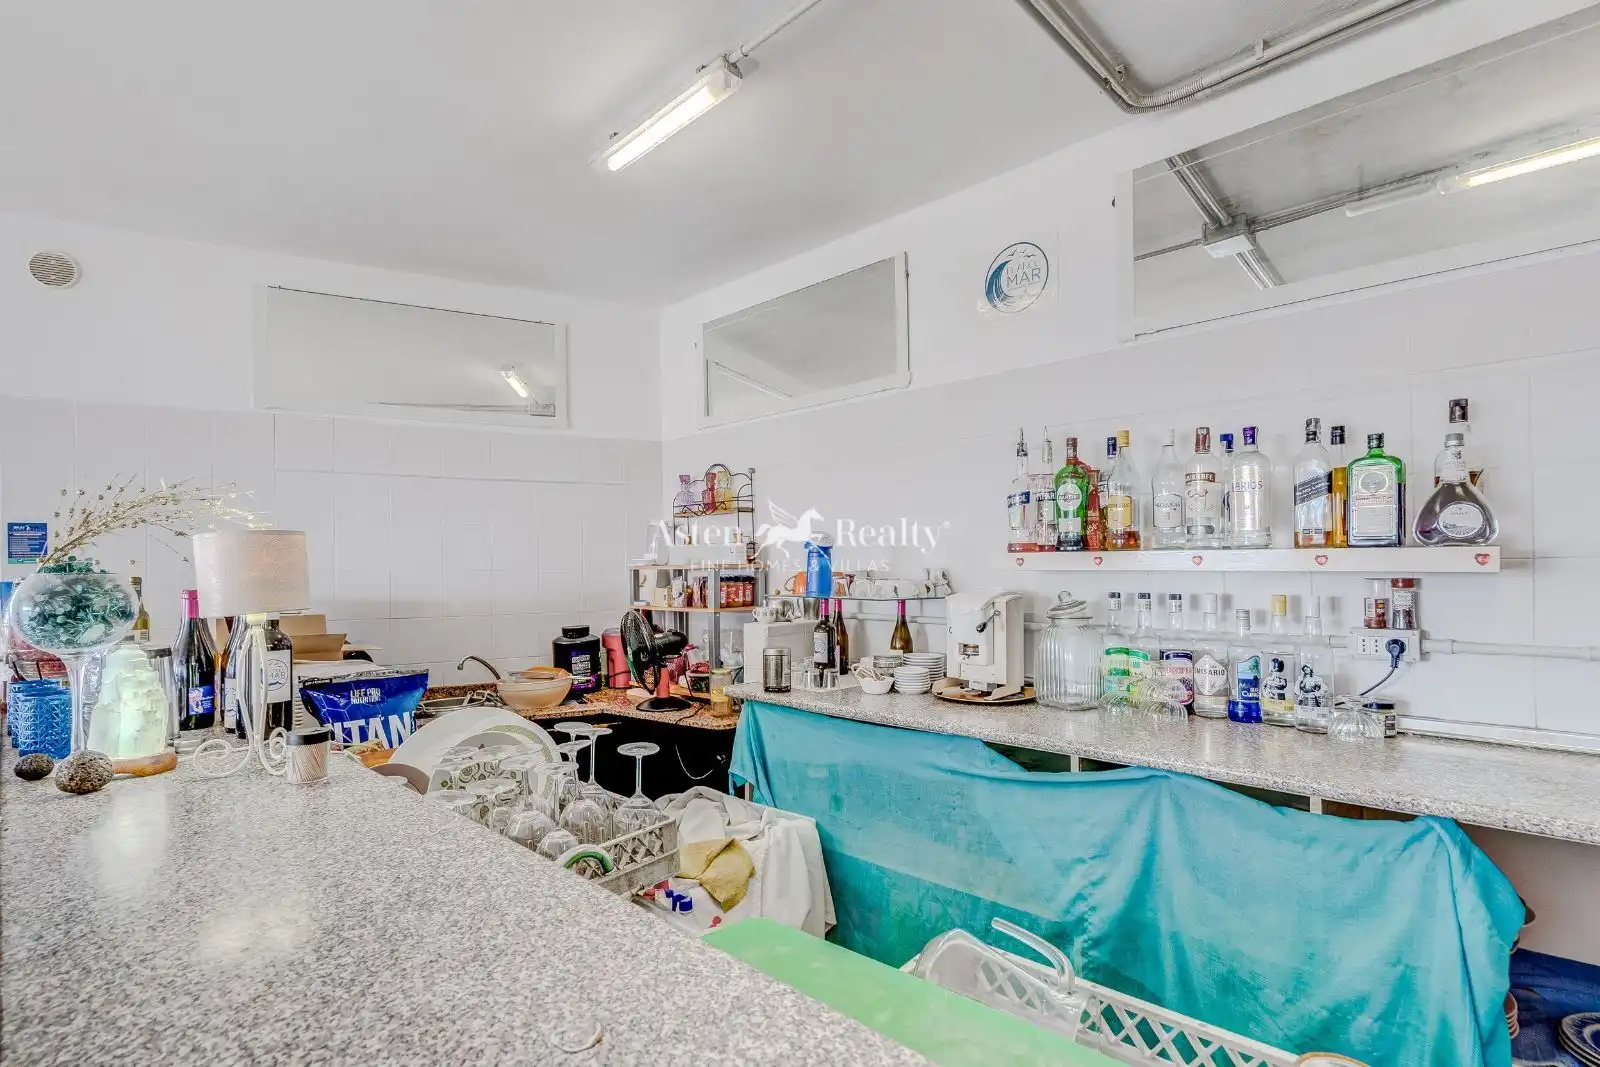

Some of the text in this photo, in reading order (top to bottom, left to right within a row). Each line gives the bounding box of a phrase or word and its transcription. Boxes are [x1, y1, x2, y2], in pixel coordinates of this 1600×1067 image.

[1007, 267, 1042, 290] MAR
[350, 687, 381, 699] LIFE PRO
